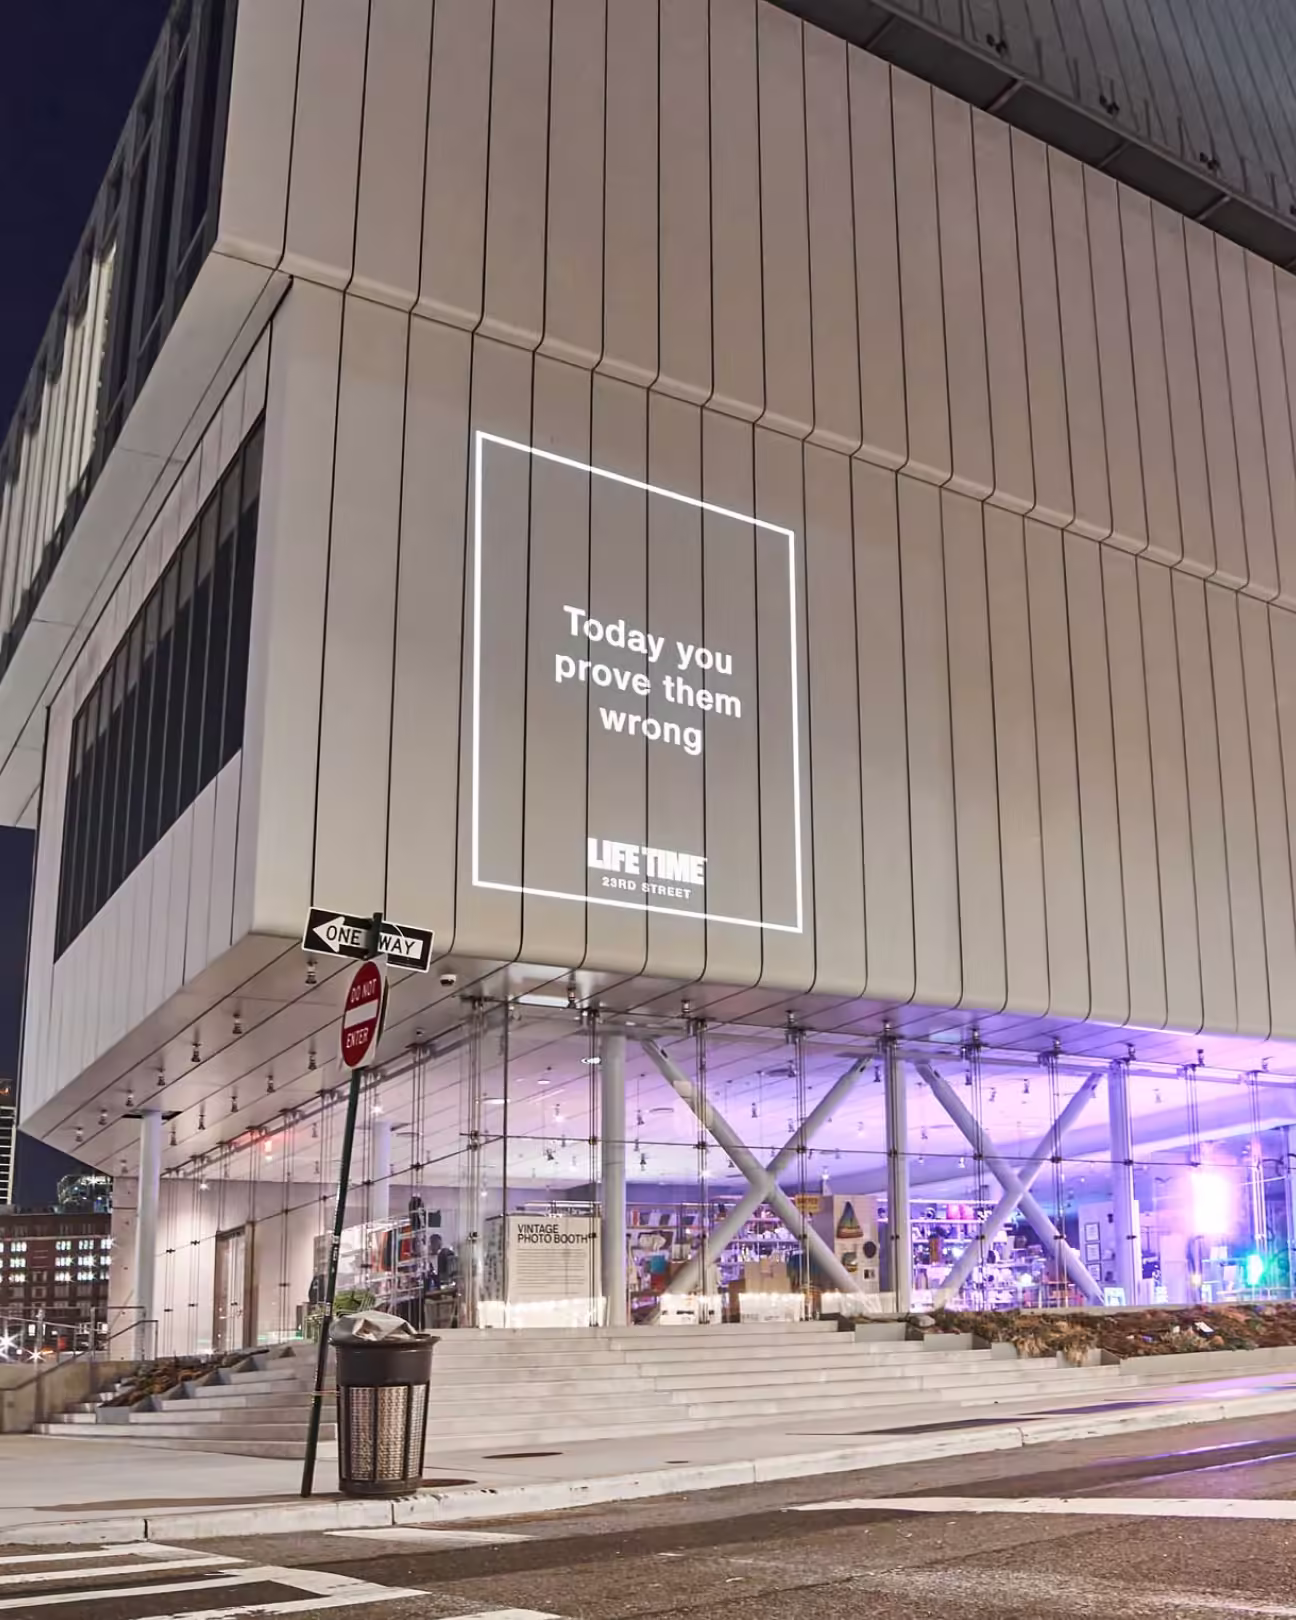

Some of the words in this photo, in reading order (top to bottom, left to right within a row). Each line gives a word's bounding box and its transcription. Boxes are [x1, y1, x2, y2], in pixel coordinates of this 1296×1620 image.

[563, 604, 665, 663] Today
[676, 640, 733, 676] you
[555, 653, 651, 697] prove
[662, 674, 742, 719] them
[599, 706, 703, 756] wrong
[602, 876, 637, 891] 23RD
[641, 882, 692, 900] STREET
[326, 925, 362, 946] ONE
[379, 934, 415, 955] WAY
[351, 985, 361, 1003] DO
[361, 978, 377, 999] NOT
[346, 1027, 369, 1049] ENTER
[517, 1224, 559, 1233] VINTAGE
[517, 1233, 552, 1244] PHOTO
[554, 1233, 588, 1244] BOOTH
